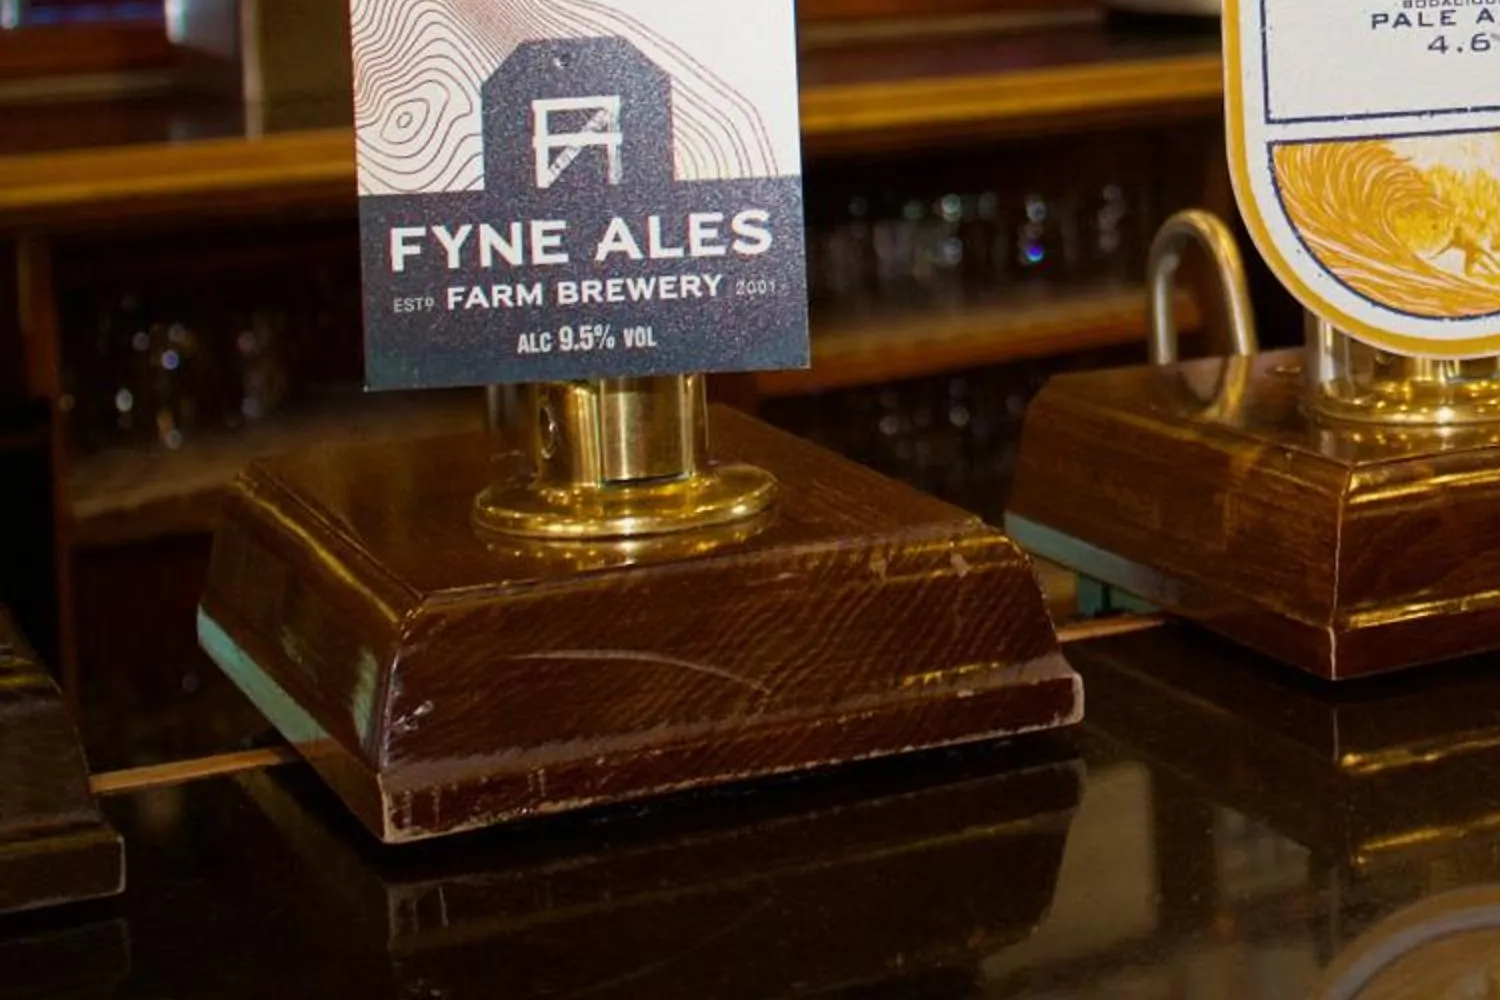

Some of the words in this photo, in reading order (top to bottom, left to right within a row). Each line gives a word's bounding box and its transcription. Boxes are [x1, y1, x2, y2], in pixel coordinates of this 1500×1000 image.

[1371, 10, 1457, 30] PALE
[390, 220, 569, 271] FYNE
[595, 209, 773, 261] ALES
[447, 283, 543, 311] FARM
[557, 274, 722, 304] BREWERY
[518, 333, 551, 354] ALC
[559, 324, 614, 352] 9.5%
[623, 327, 656, 349] VOL
